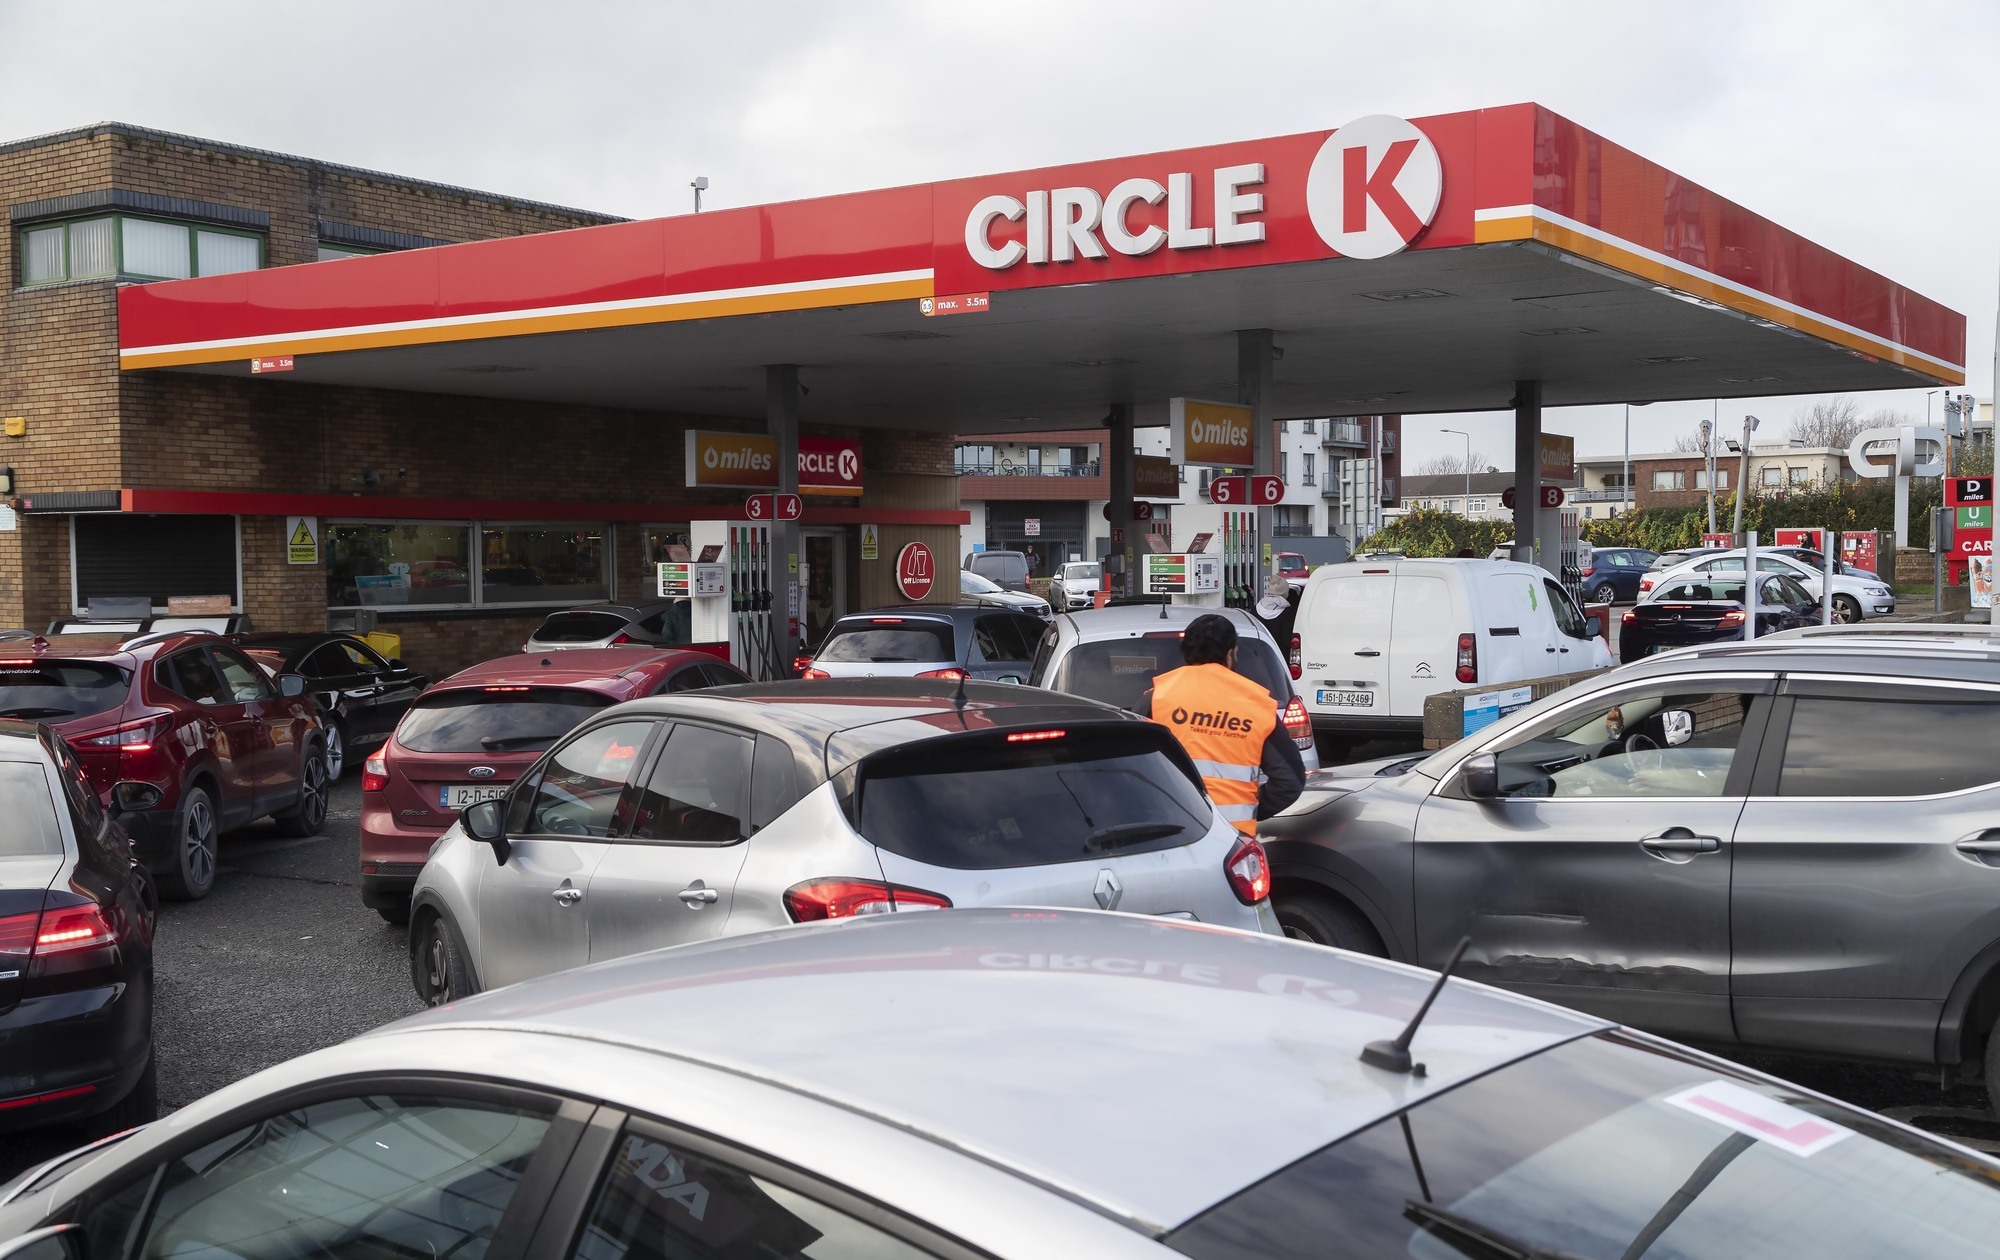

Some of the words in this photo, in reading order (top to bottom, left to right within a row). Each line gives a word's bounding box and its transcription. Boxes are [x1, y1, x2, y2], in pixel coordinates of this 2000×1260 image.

[964, 162, 1266, 271] CIRCLE
[938, 301, 959, 310] max.
[966, 297, 988, 307] 3.5m
[1205, 419, 1249, 447] miles
[720, 447, 772, 471] miles
[1217, 481, 1230, 502] 5
[1264, 480, 1278, 501] 6
[1966, 480, 1981, 493] D
[1547, 489, 1558, 505] 8
[1963, 493, 1984, 501] miles
[751, 499, 761, 517] 3
[786, 498, 797, 516] 4
[1139, 504, 1148, 519] 2
[1968, 507, 1980, 519] U
[1964, 520, 1984, 528] miles
[1189, 710, 1253, 733] miles
